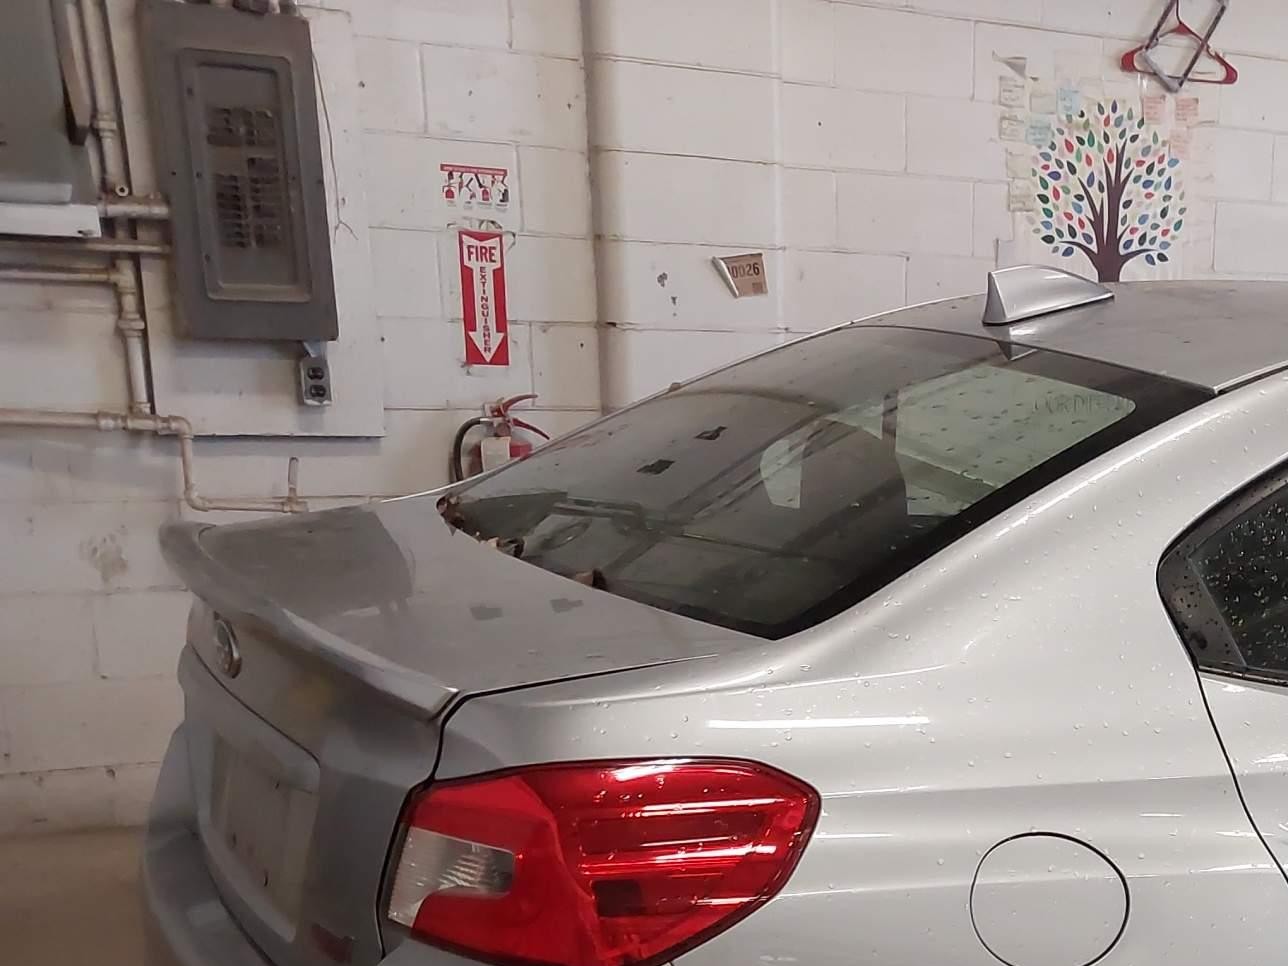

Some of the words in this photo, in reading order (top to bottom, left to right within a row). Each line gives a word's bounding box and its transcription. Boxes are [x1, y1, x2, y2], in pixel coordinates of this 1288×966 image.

[467, 244, 497, 263] FIRE
[727, 262, 760, 278] 0026
[480, 266, 491, 353] EXTINGUISHER
